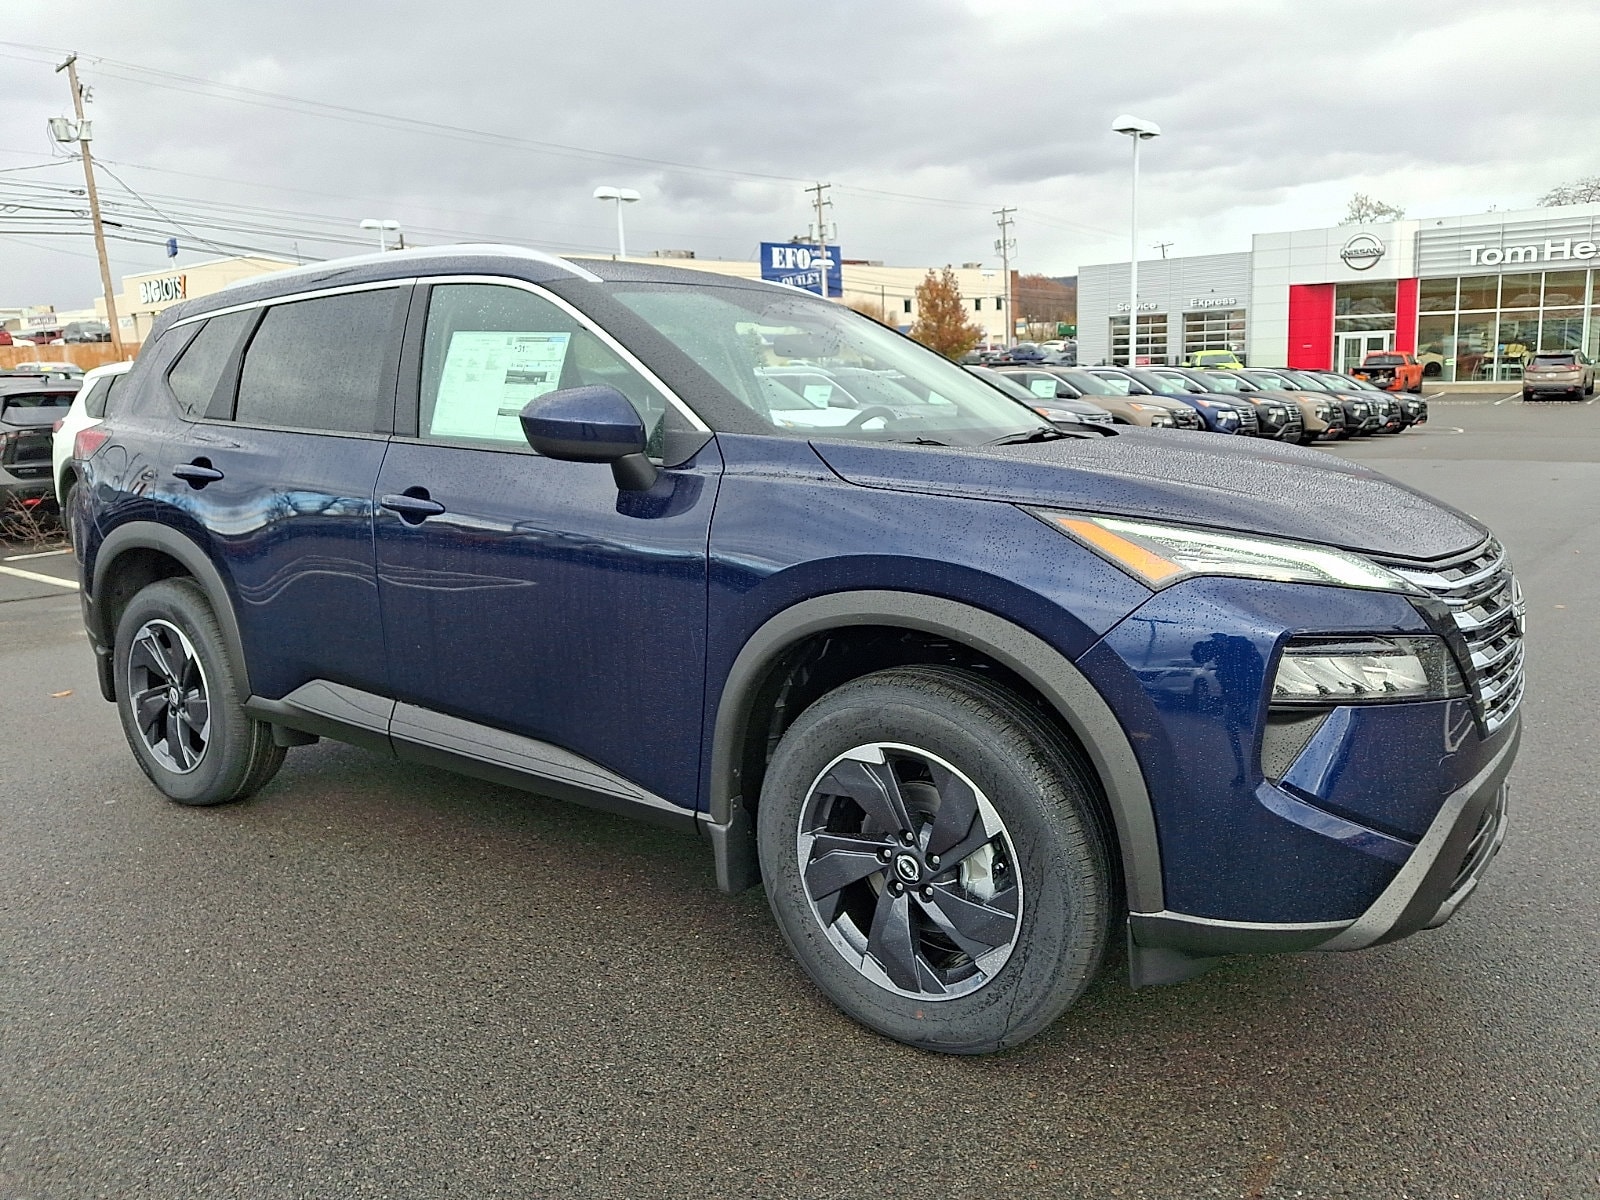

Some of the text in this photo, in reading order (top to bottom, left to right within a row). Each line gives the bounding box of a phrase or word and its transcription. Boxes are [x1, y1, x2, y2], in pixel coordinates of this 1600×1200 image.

[1344, 247, 1381, 256] NISSAN
[1463, 238, 1600, 266] Tom He
[771, 247, 811, 270] EFO
[1117, 302, 1157, 311] Sevice
[1190, 297, 1237, 308] Express
